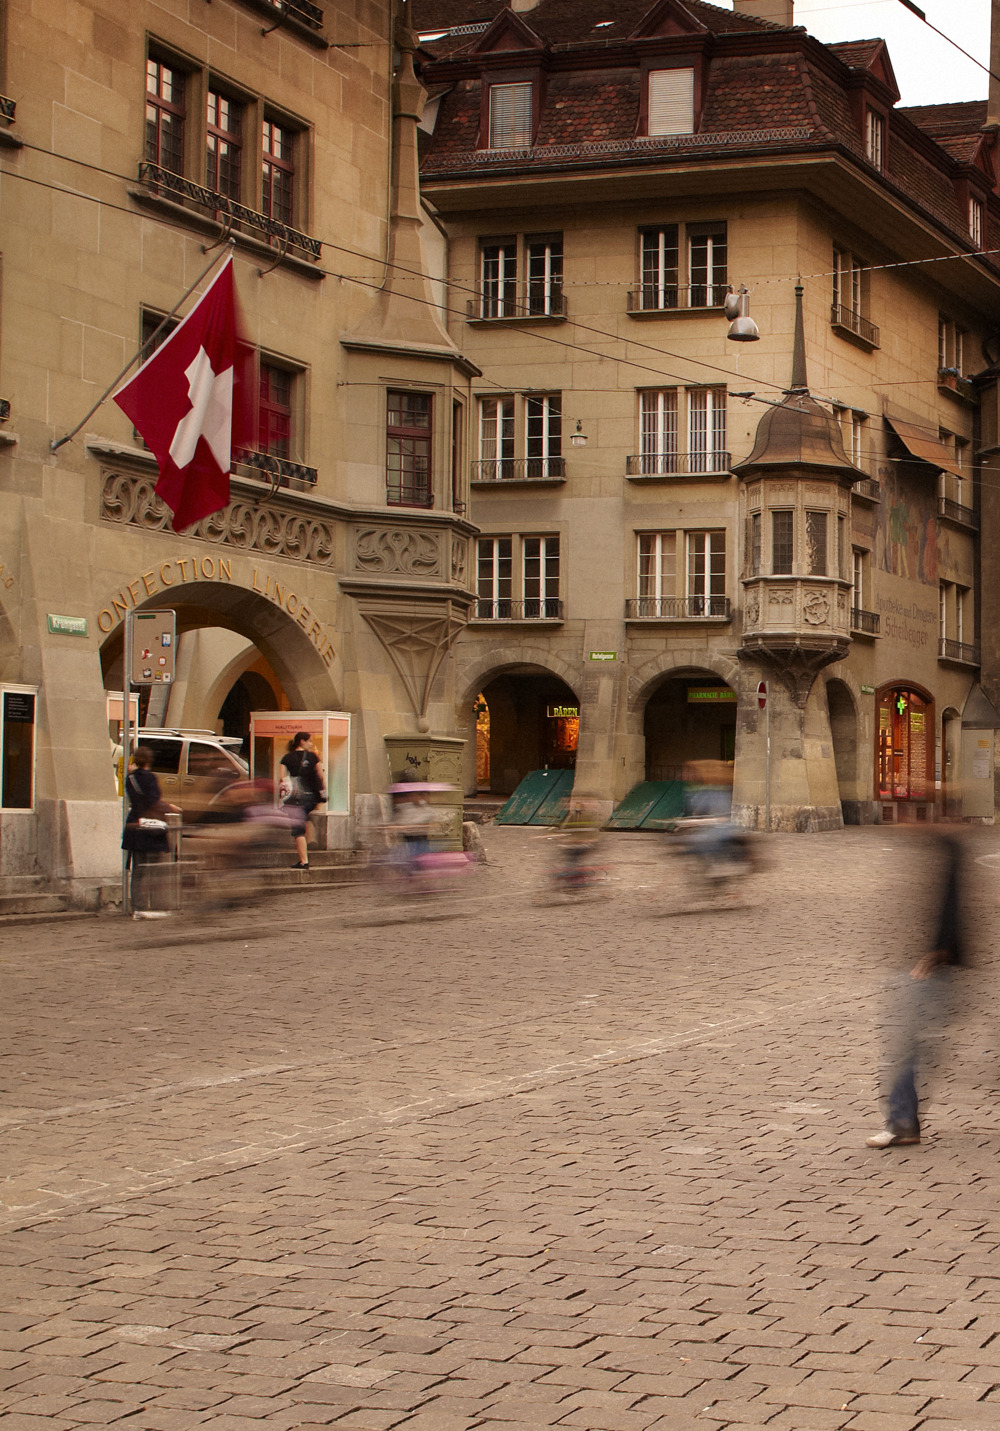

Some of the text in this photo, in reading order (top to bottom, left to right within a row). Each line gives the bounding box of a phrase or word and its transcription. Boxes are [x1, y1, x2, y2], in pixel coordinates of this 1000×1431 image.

[97, 556, 337, 668] ONFECTION LINGERIE
[553, 705, 578, 717] BÄREN
